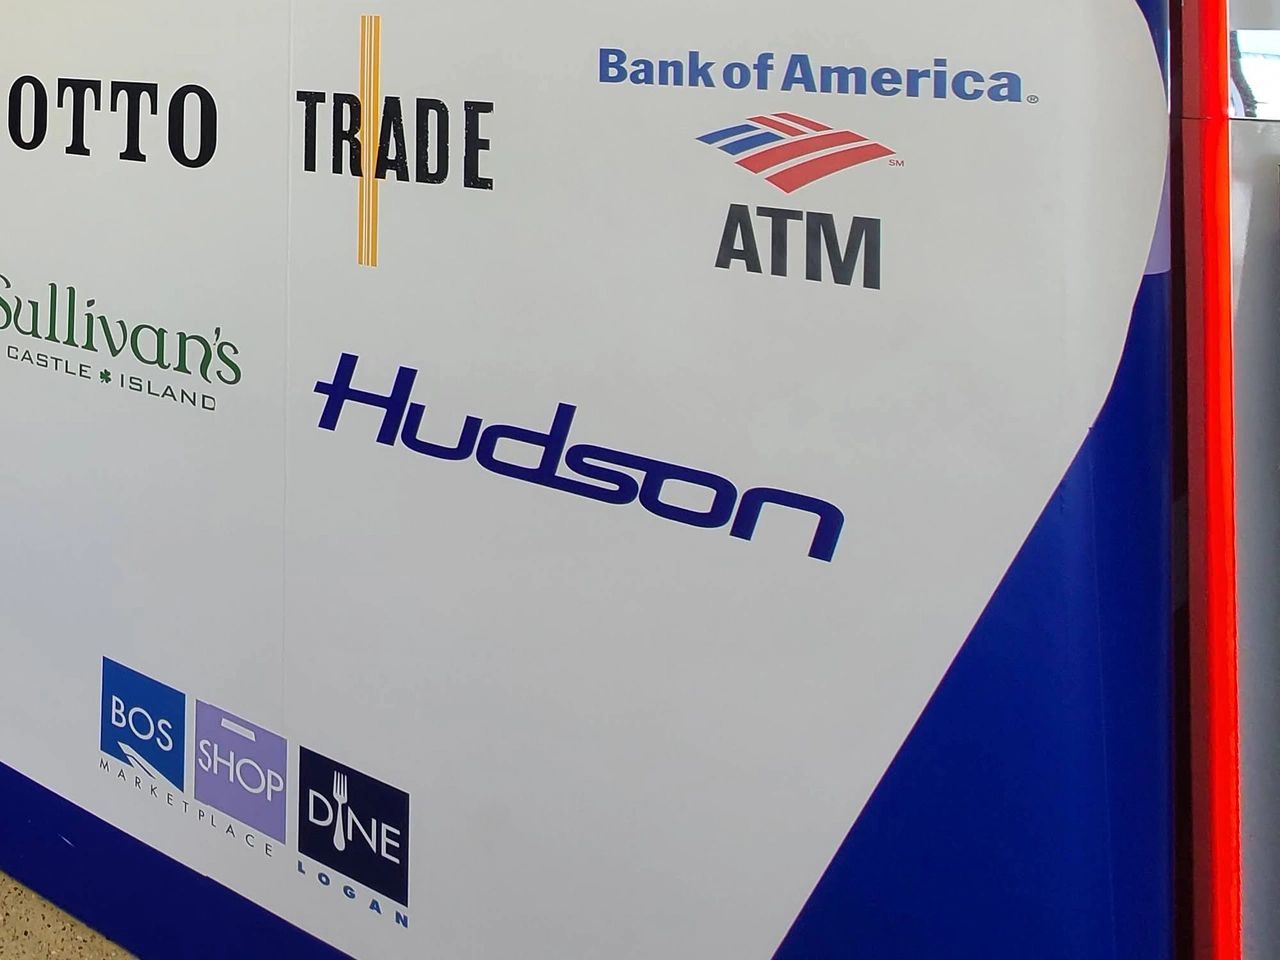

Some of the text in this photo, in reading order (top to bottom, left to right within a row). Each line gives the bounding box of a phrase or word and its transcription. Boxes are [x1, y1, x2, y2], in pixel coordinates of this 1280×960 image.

[8, 75, 218, 168] OTTO
[599, 47, 1023, 103] Bank of America
[296, 90, 494, 190] TRADE
[714, 203, 881, 290] ATM
[7, 345, 217, 412] CASTLE ISLAND
[313, 352, 845, 563] Hudson
[111, 695, 174, 752] BOS
[198, 739, 284, 802] SHOP
[99, 758, 409, 929] MARKETPLACE LOGAN
